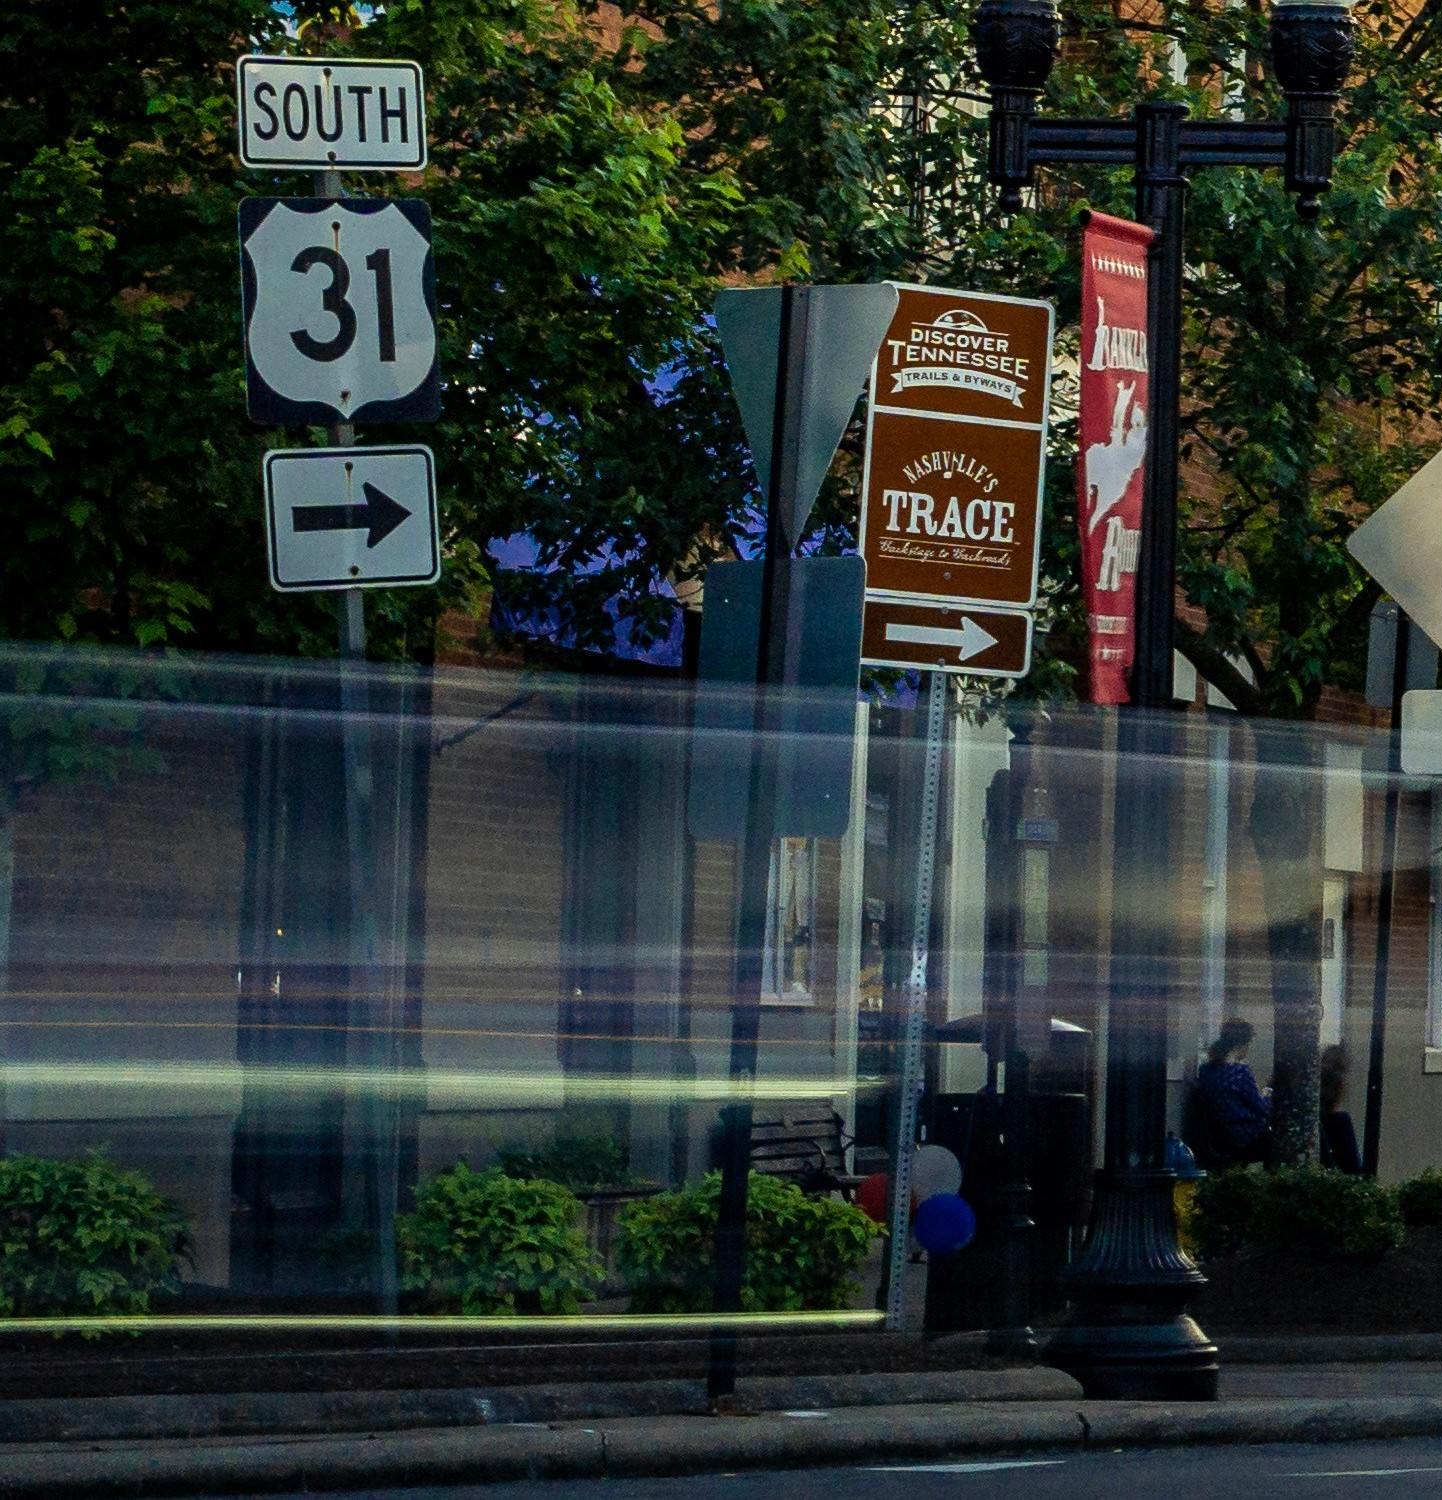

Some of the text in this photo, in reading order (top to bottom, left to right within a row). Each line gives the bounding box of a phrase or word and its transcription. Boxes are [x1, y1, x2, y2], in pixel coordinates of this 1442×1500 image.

[253, 82, 409, 144] SOUTH
[289, 245, 396, 362] 31
[887, 339, 1030, 381] TENNESSEE
[910, 328, 1009, 353] DISCOVER
[905, 372, 1012, 393] TRAILS & BYWAYS
[902, 450, 999, 493] NASHVILLE'S
[882, 489, 1015, 543] TRACE
